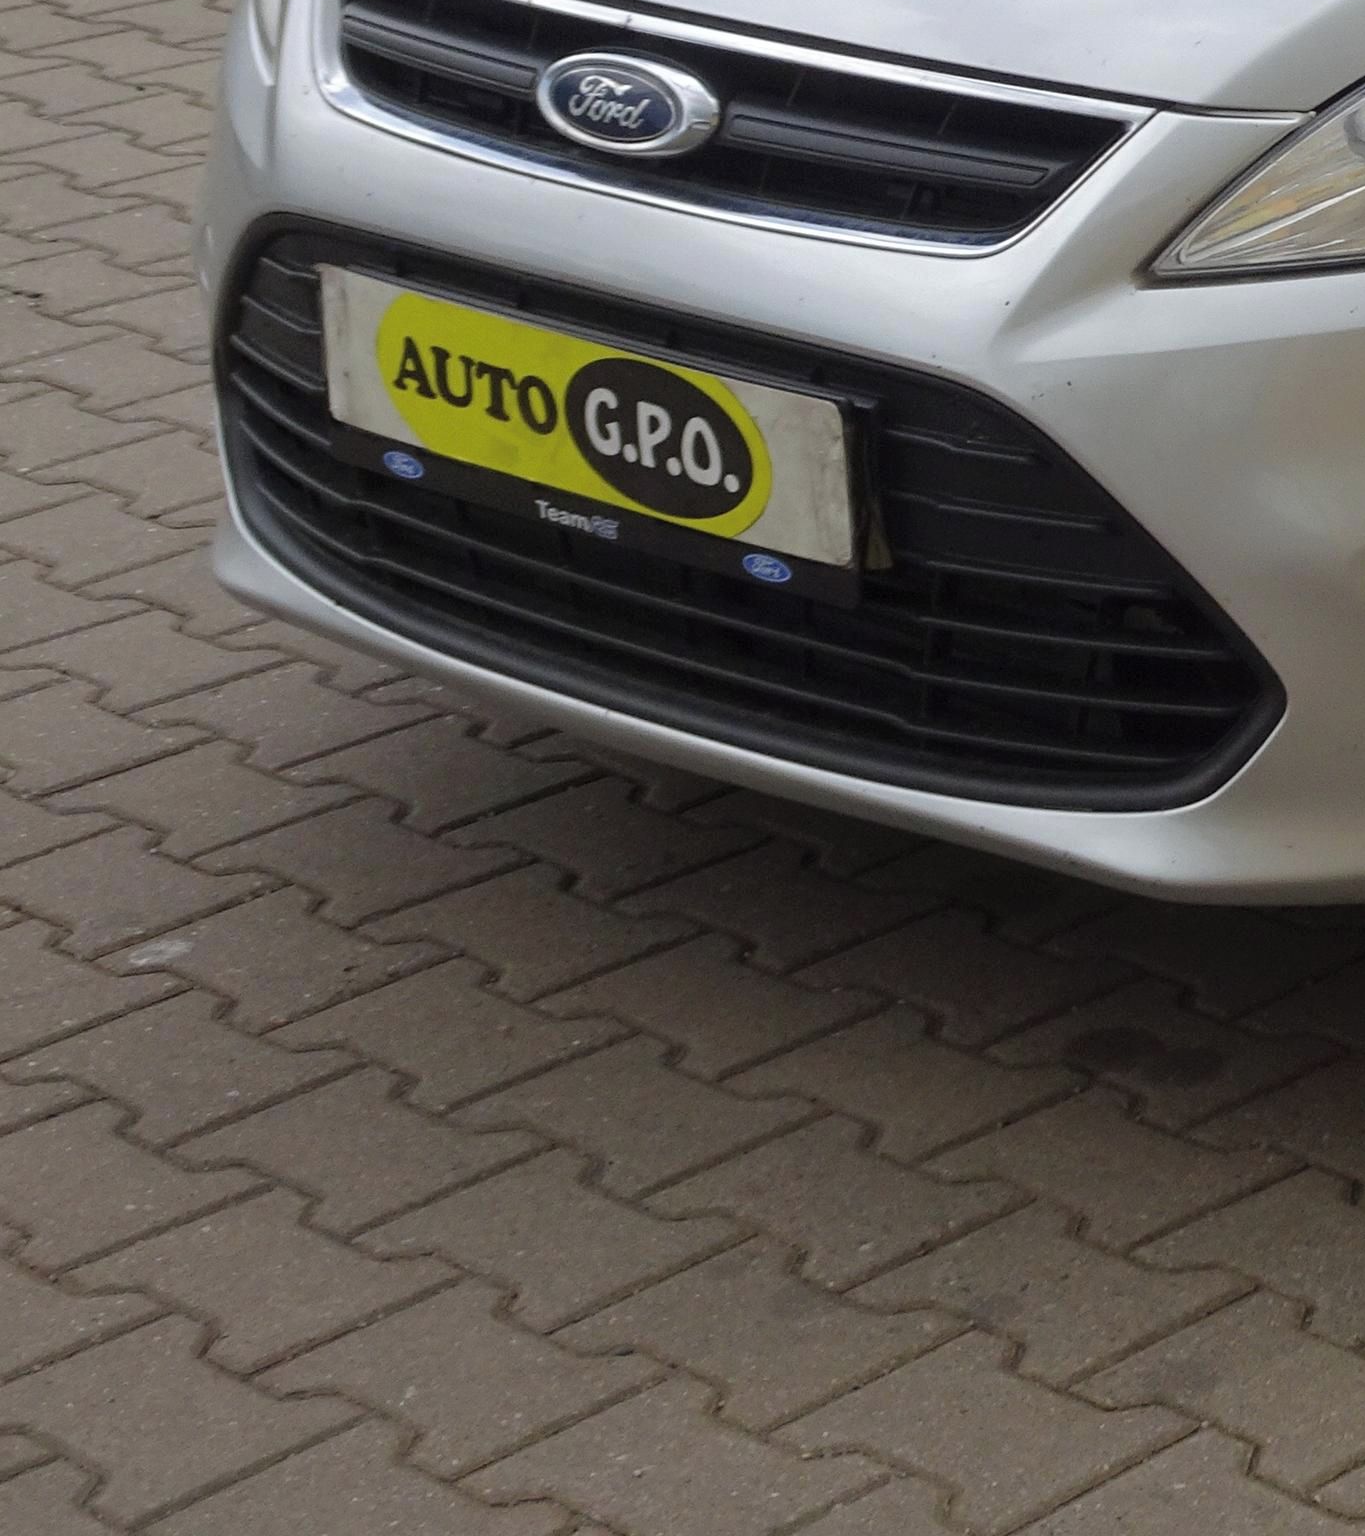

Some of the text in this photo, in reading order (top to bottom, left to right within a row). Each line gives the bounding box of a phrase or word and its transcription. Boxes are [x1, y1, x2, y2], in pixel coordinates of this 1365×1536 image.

[568, 74, 652, 130] Ford
[392, 335, 740, 493] AUTO G.P.O.
